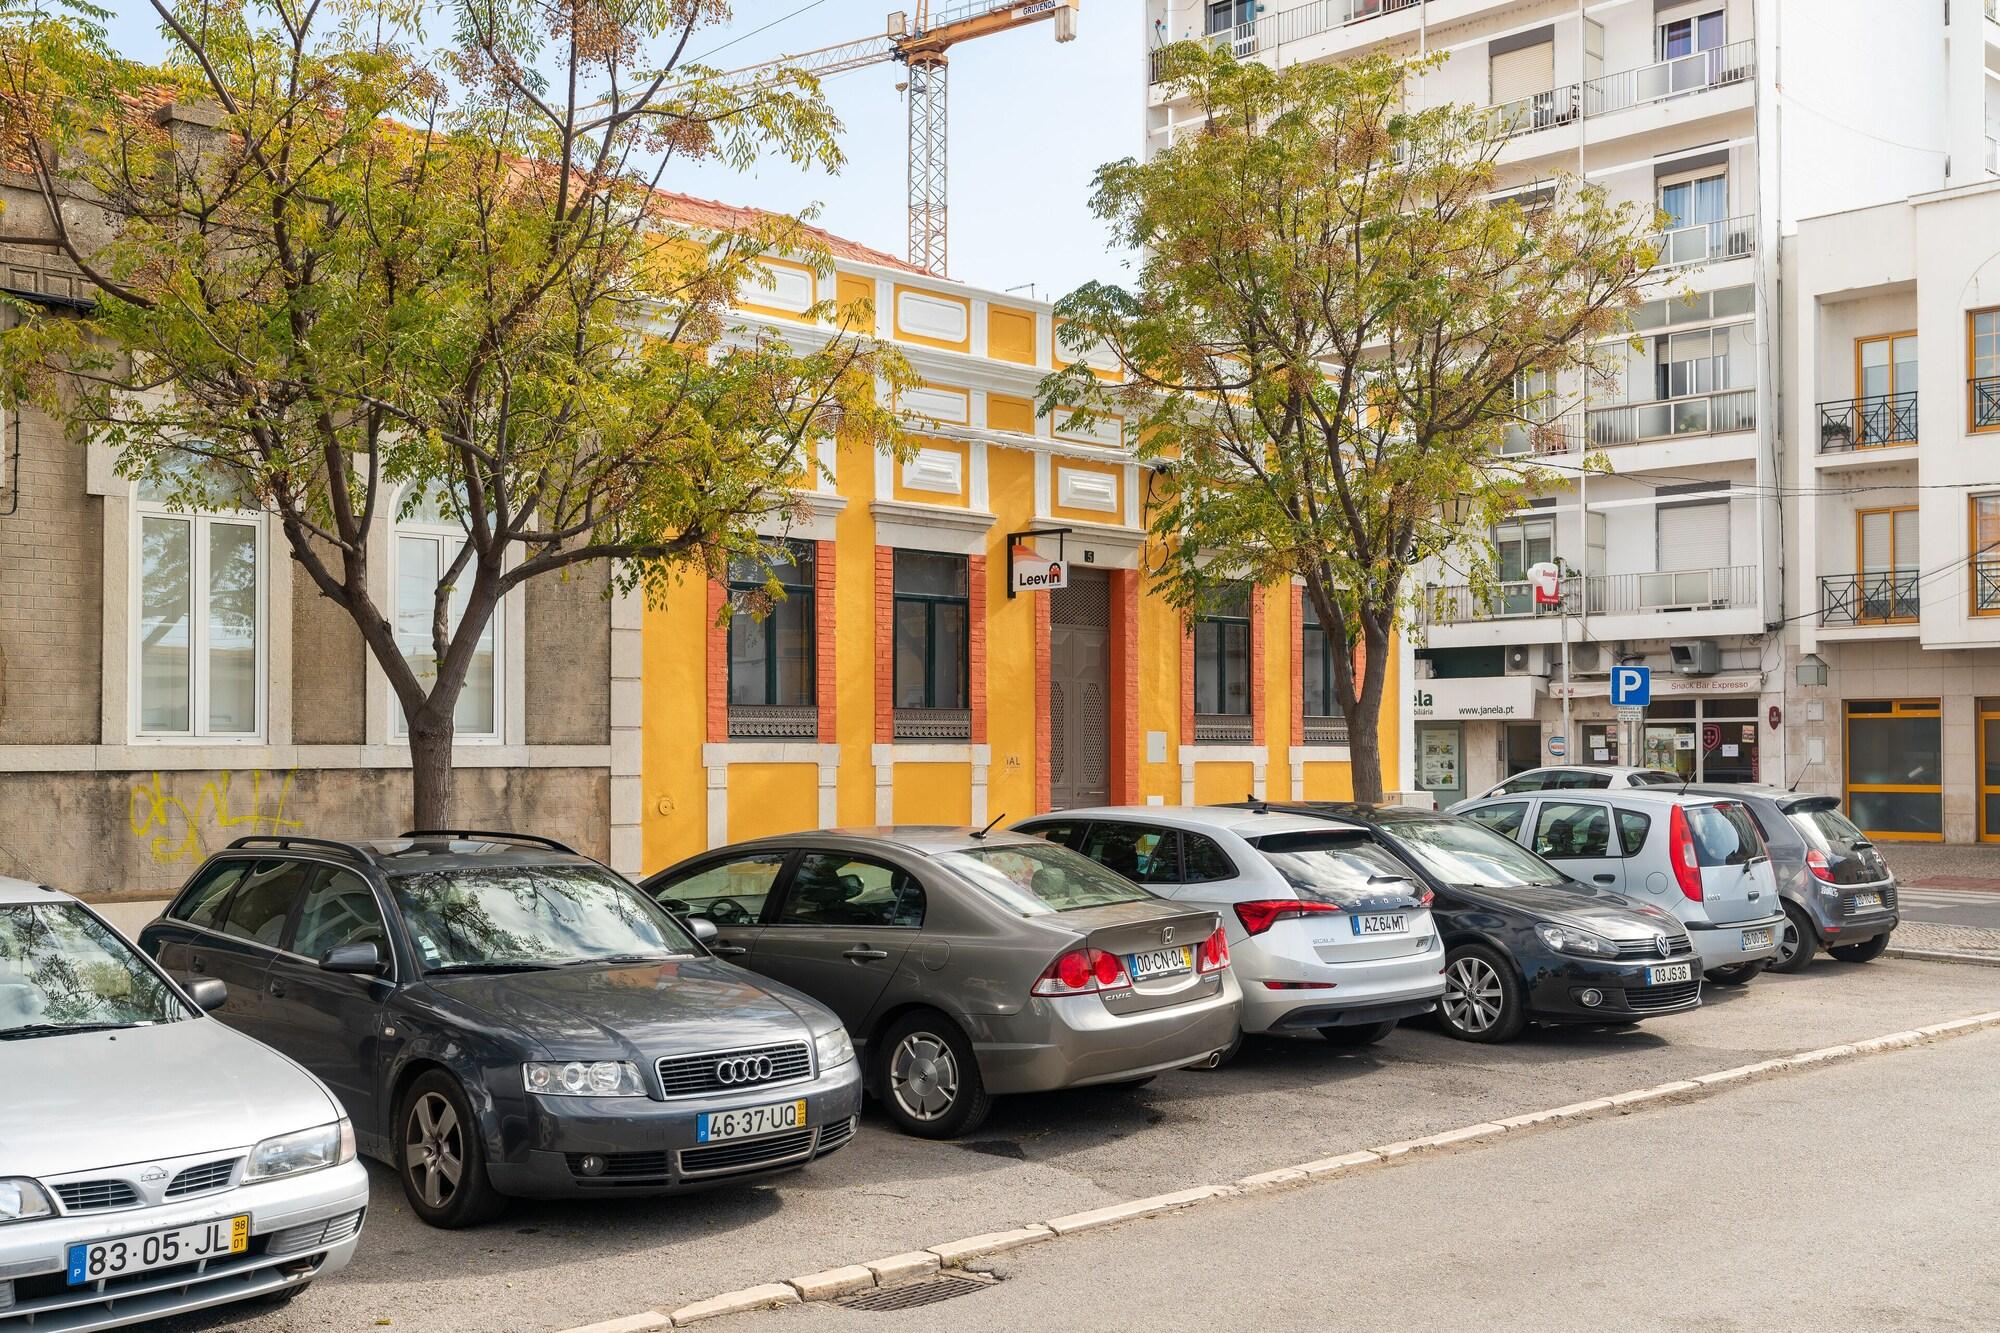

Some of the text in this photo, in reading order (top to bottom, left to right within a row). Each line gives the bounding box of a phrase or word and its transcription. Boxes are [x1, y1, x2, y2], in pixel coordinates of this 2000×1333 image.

[1023, 0, 1056, 15] GRUVENDA
[1019, 573, 1061, 586] Leevin
[1620, 670, 1642, 702] P
[1671, 681, 1748, 690] Snack Bar Expresso
[1458, 705, 1515, 716] www.janela.pt
[1105, 992, 1132, 1001] CIVIC
[234, 1220, 246, 1231] 98
[233, 1238, 244, 1249] 01
[74, 1268, 81, 1277] P
